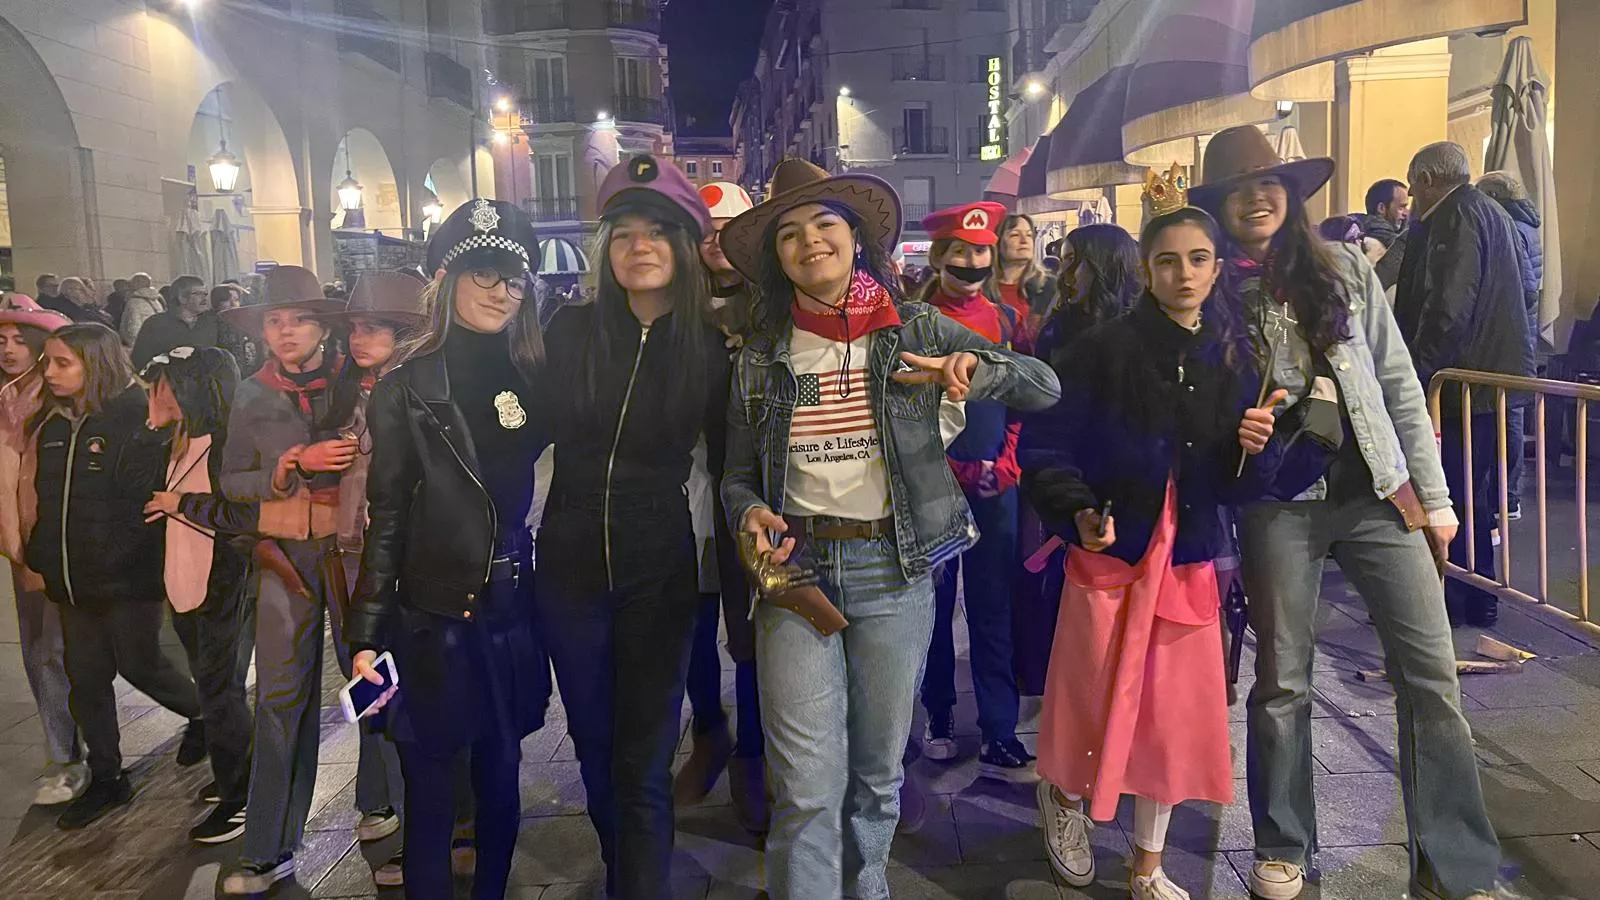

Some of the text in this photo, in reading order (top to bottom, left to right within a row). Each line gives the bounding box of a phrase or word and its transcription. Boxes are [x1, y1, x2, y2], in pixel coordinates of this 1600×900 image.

[988, 57, 1001, 143] HOSTAL
[965, 213, 985, 227] M
[789, 436, 879, 453] eisure & Lifestyle
[806, 454, 821, 463] Los
